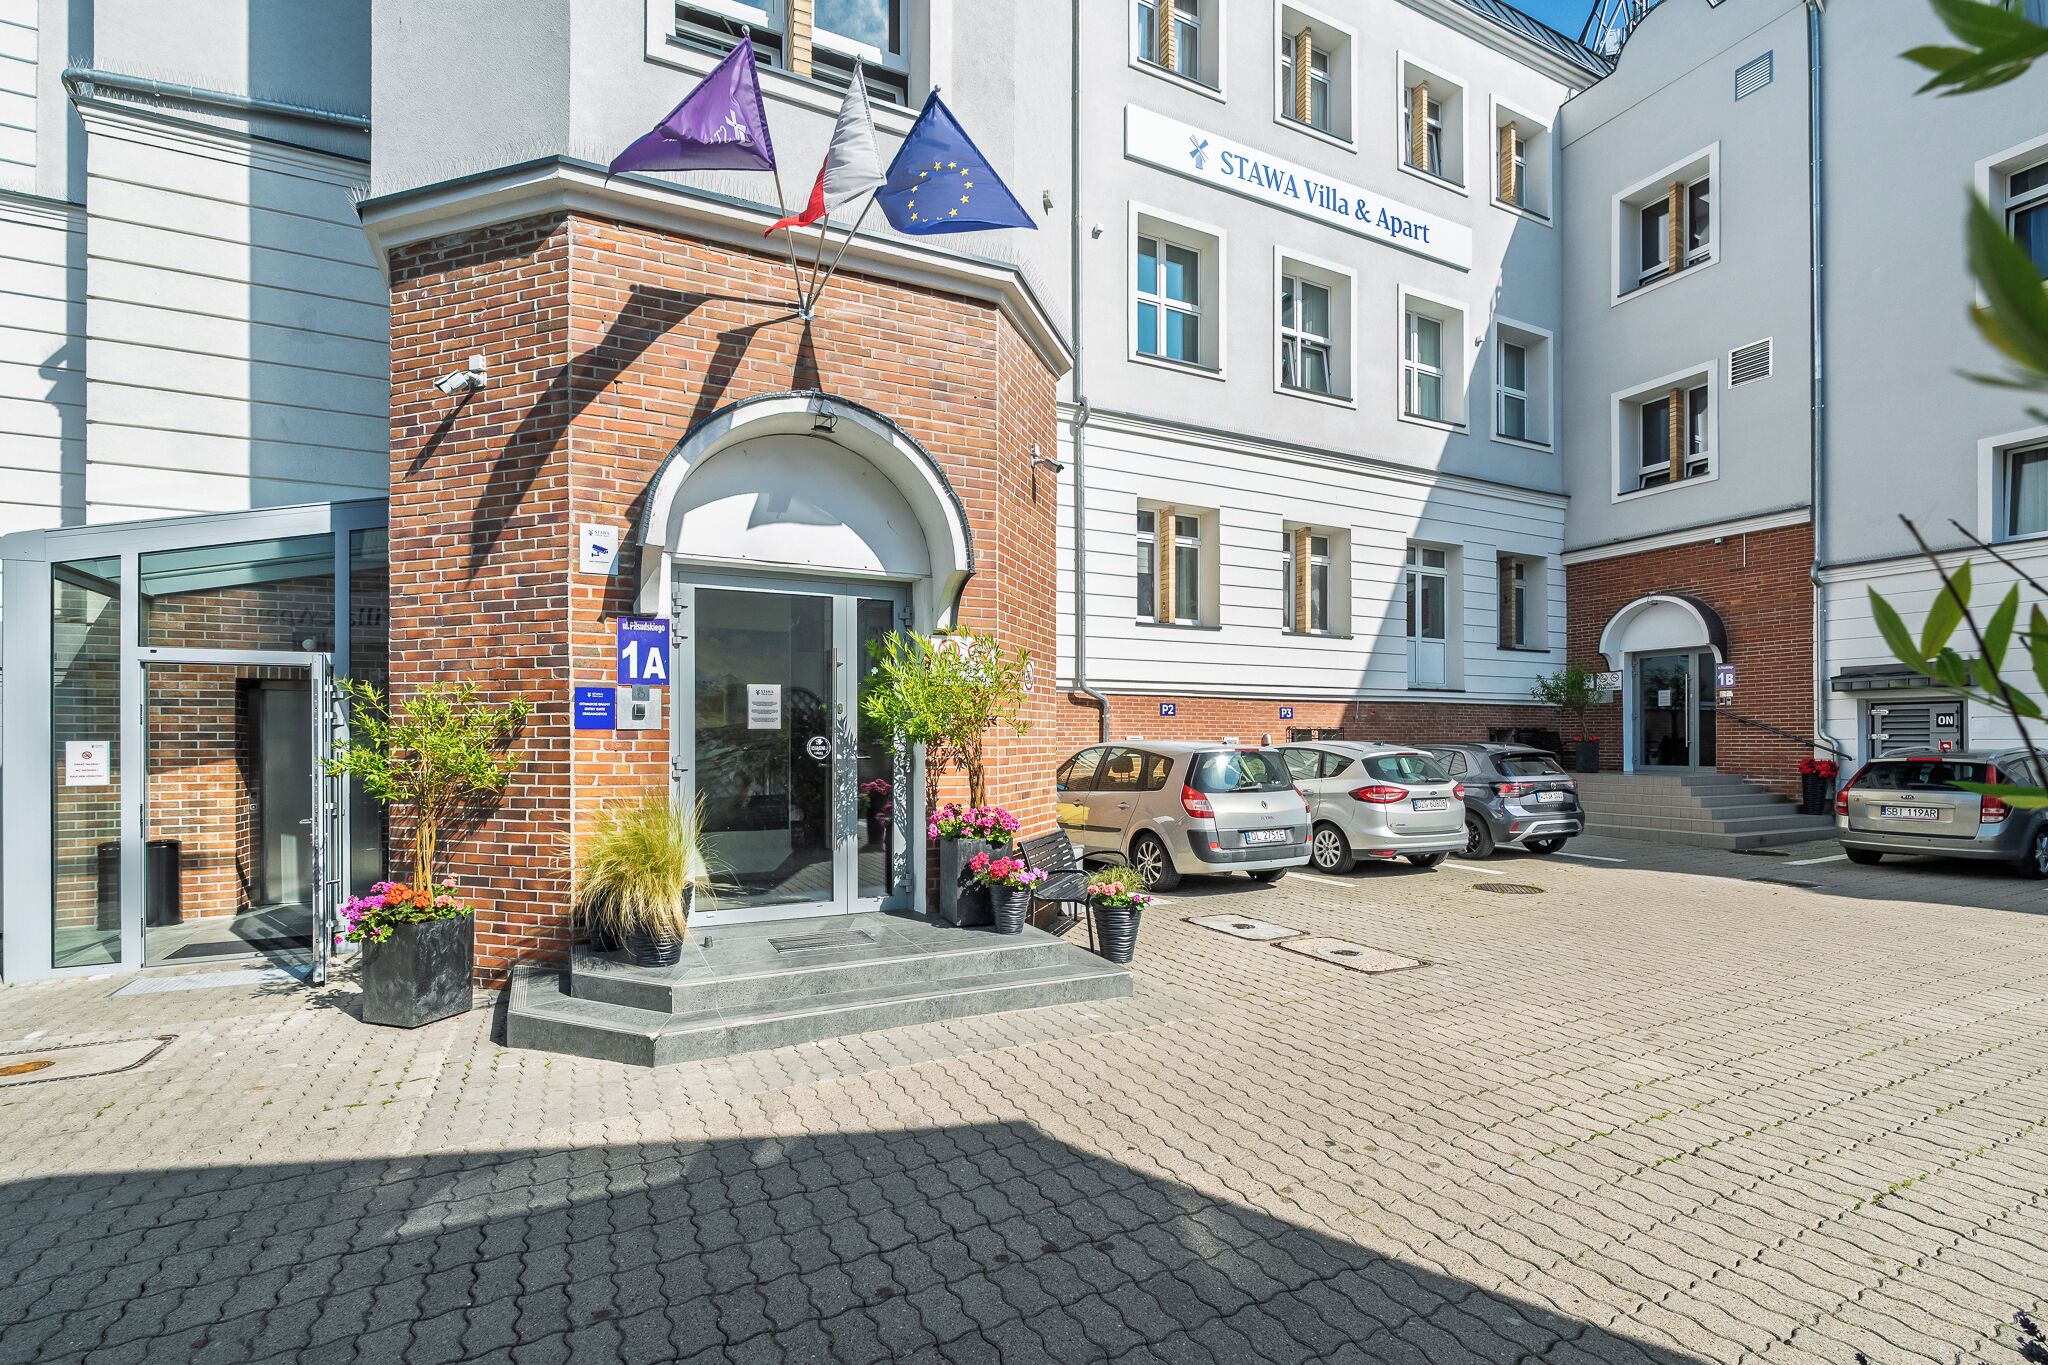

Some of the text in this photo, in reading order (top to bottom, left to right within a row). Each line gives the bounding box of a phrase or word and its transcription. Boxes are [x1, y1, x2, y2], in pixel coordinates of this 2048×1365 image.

[1220, 150, 1431, 244] STAWA Villa & Apart
[621, 640, 667, 680] 1A
[1718, 672, 1734, 686] 1B
[1161, 704, 1175, 715] P2
[1281, 709, 1292, 718] P3
[1937, 715, 1953, 725] ON
[1886, 807, 1937, 818] SBI 119AR
